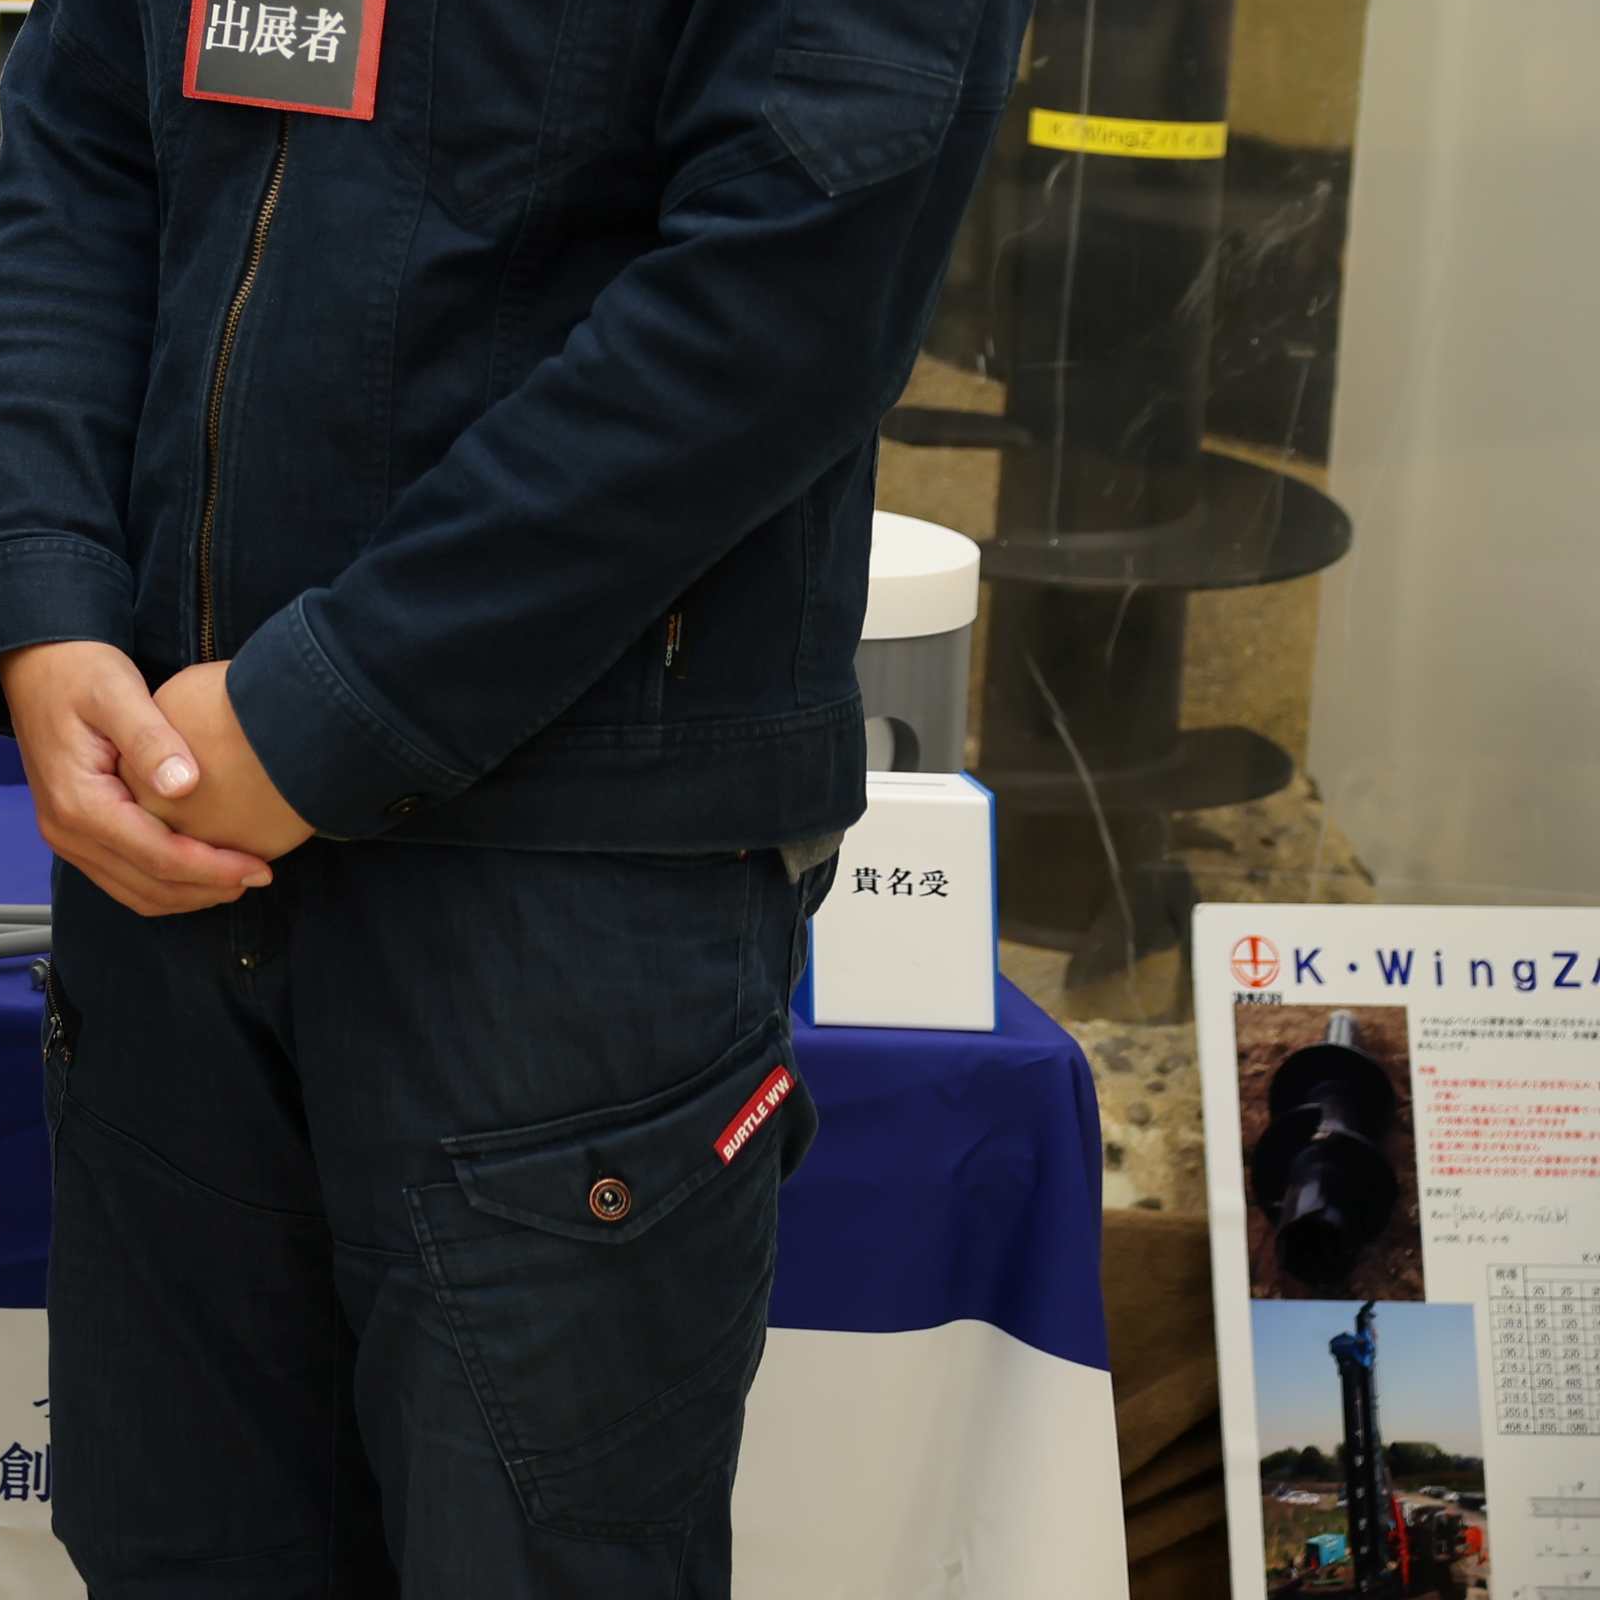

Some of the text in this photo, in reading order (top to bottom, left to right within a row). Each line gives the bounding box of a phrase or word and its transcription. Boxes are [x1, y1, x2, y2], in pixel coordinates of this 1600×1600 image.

[205, 0, 347, 63] 出展者
[851, 866, 950, 898] 貴名受
[723, 1075, 790, 1161] BURTLE WW
